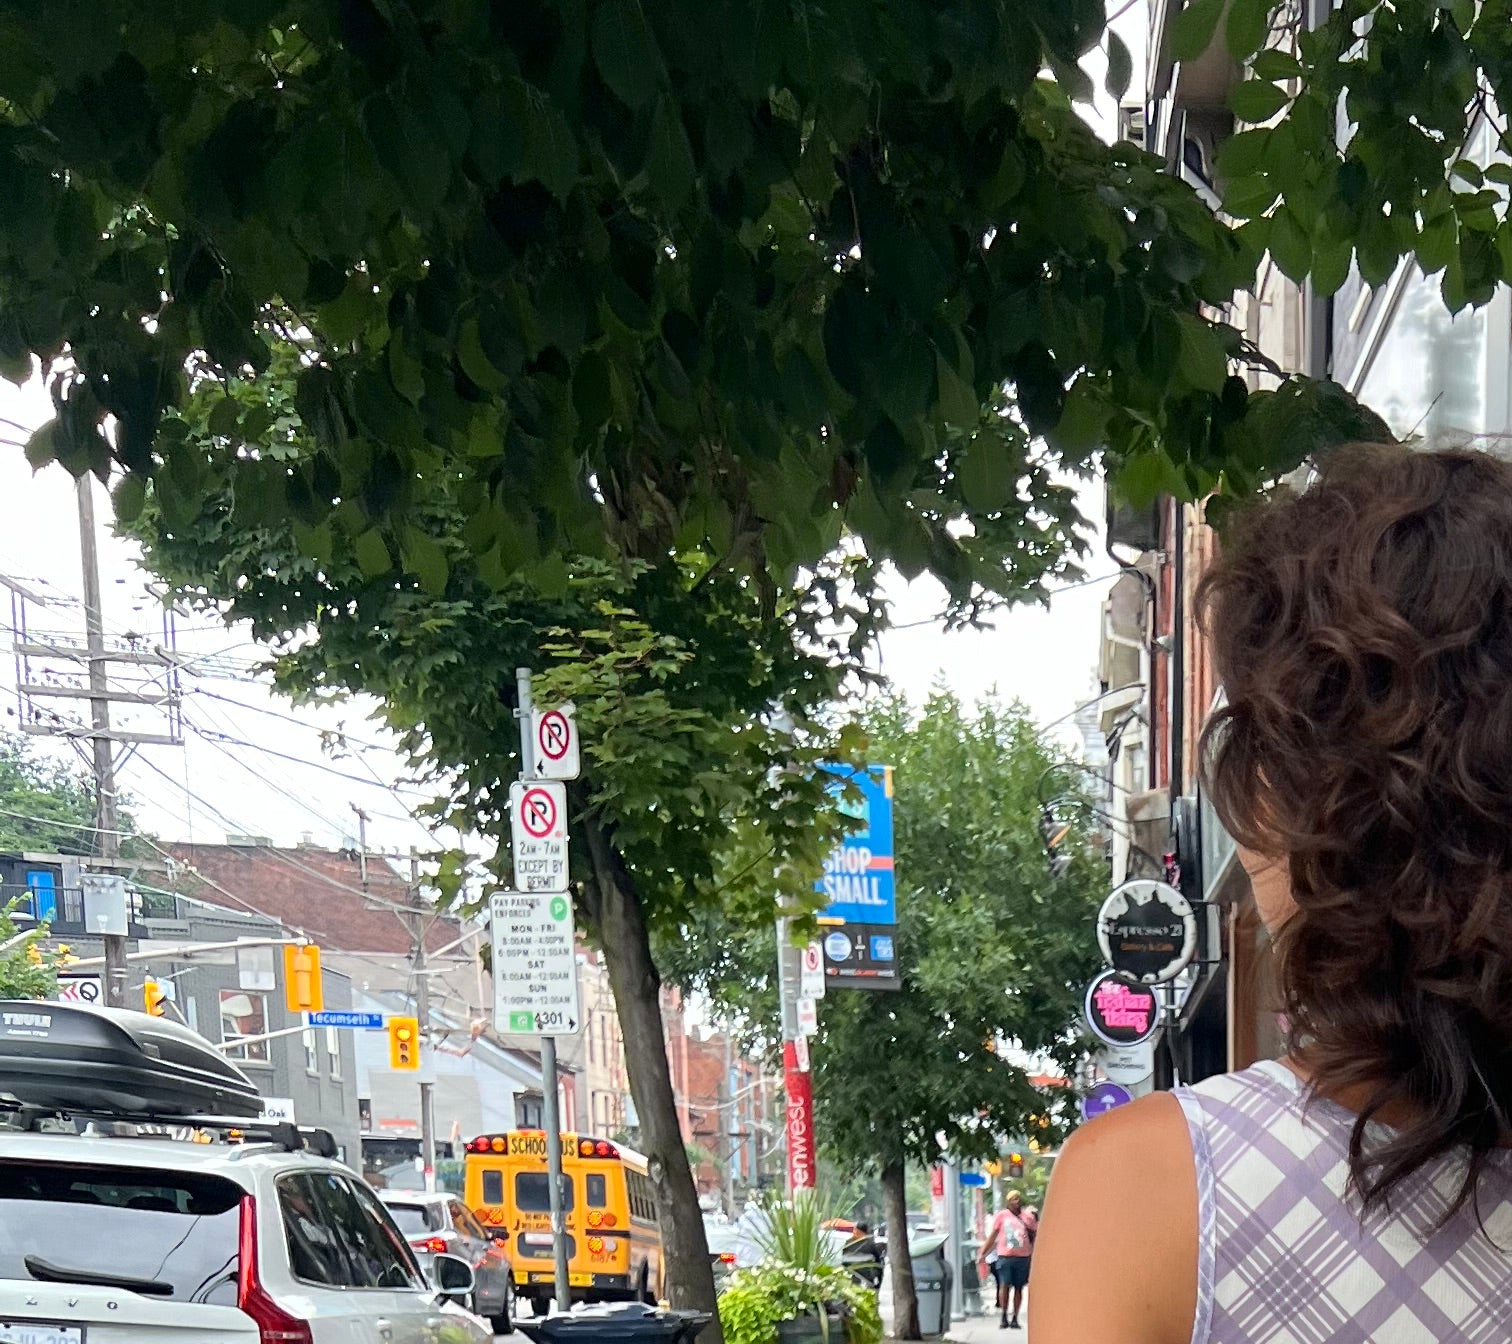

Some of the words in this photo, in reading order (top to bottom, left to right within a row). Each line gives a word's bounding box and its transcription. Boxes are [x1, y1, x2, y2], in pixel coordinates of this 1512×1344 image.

[518, 859, 548, 874] EXCEPT
[552, 859, 564, 874] BY
[823, 874, 880, 905] SMALL
[511, 924, 533, 934] MON
[541, 924, 556, 933] FRI
[527, 960, 545, 969] SAT
[528, 984, 547, 993] SUN
[534, 1012, 563, 1025] 4301
[511, 1137, 546, 1155] SCHOO
[562, 1139, 575, 1157] US
[788, 1095, 810, 1186] enwest
